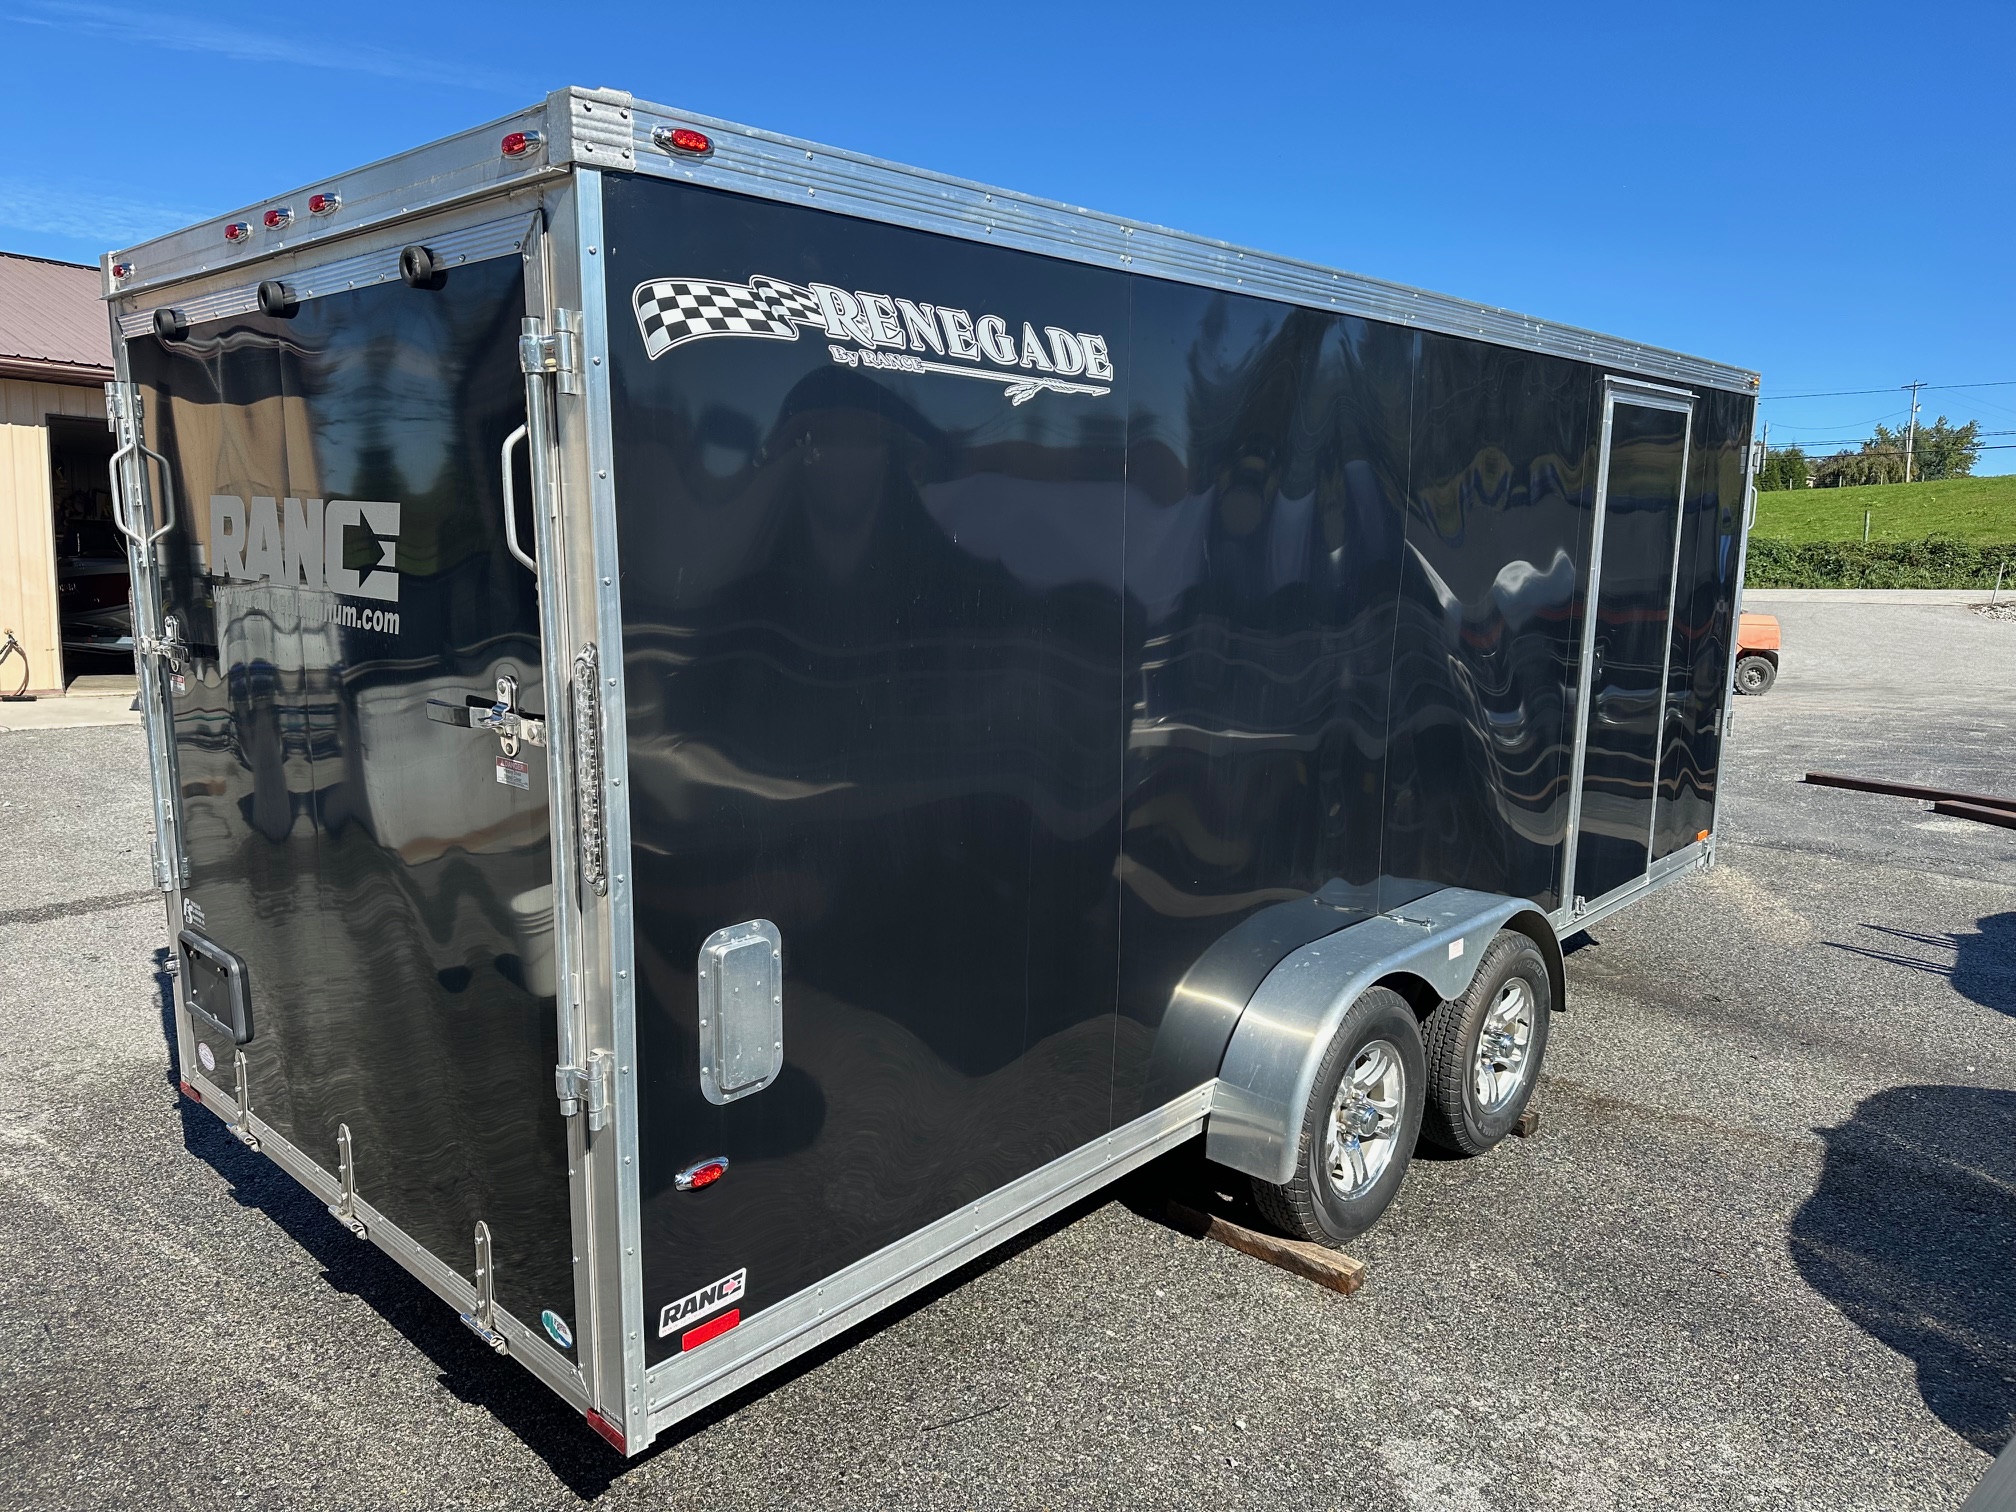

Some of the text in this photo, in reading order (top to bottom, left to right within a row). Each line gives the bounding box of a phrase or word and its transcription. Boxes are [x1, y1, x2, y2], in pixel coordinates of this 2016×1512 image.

[809, 283, 1113, 380] RENEGADE
[829, 345, 925, 373] By RANCE
[210, 495, 400, 602] RANCE
[662, 1272, 743, 1328] RANCE
